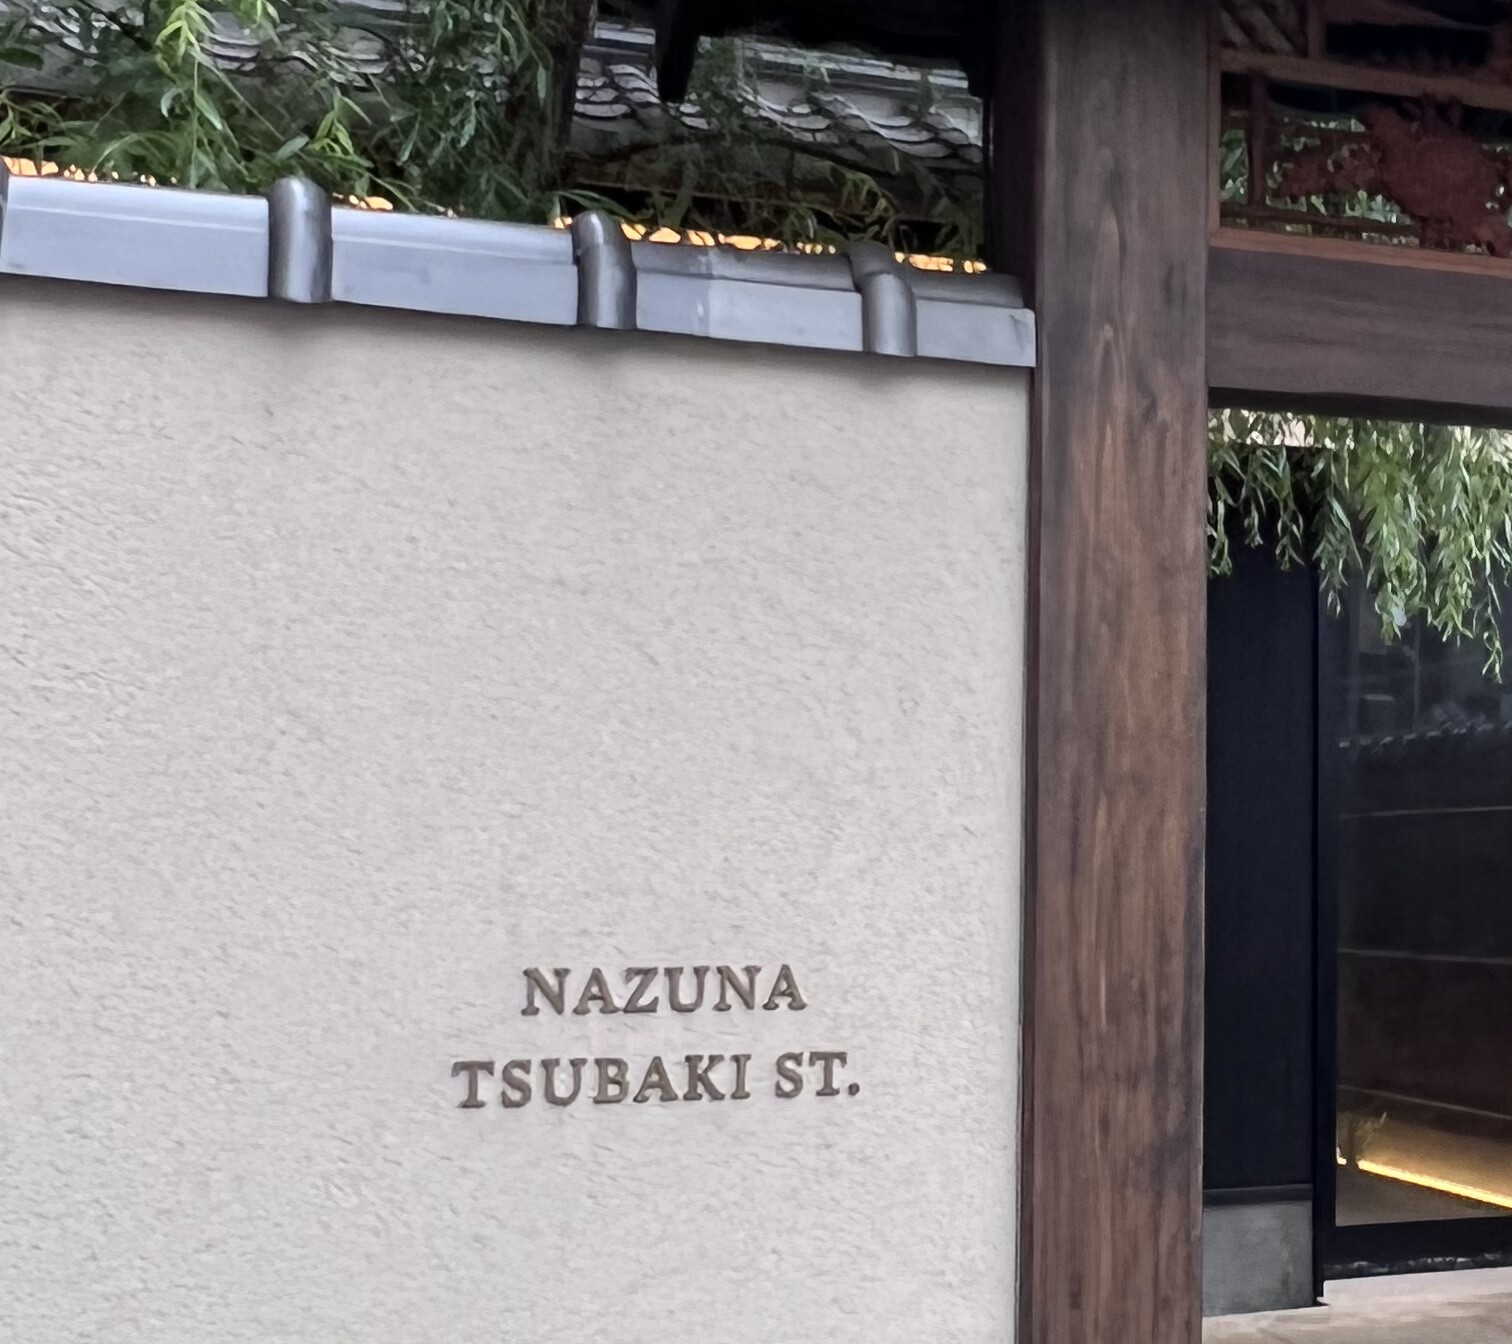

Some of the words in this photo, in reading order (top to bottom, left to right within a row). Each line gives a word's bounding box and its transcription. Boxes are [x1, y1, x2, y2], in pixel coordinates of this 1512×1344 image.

[520, 963, 808, 1017] NAZUNA
[451, 1053, 753, 1110] TSUBAKI
[774, 1051, 861, 1100] ST.
